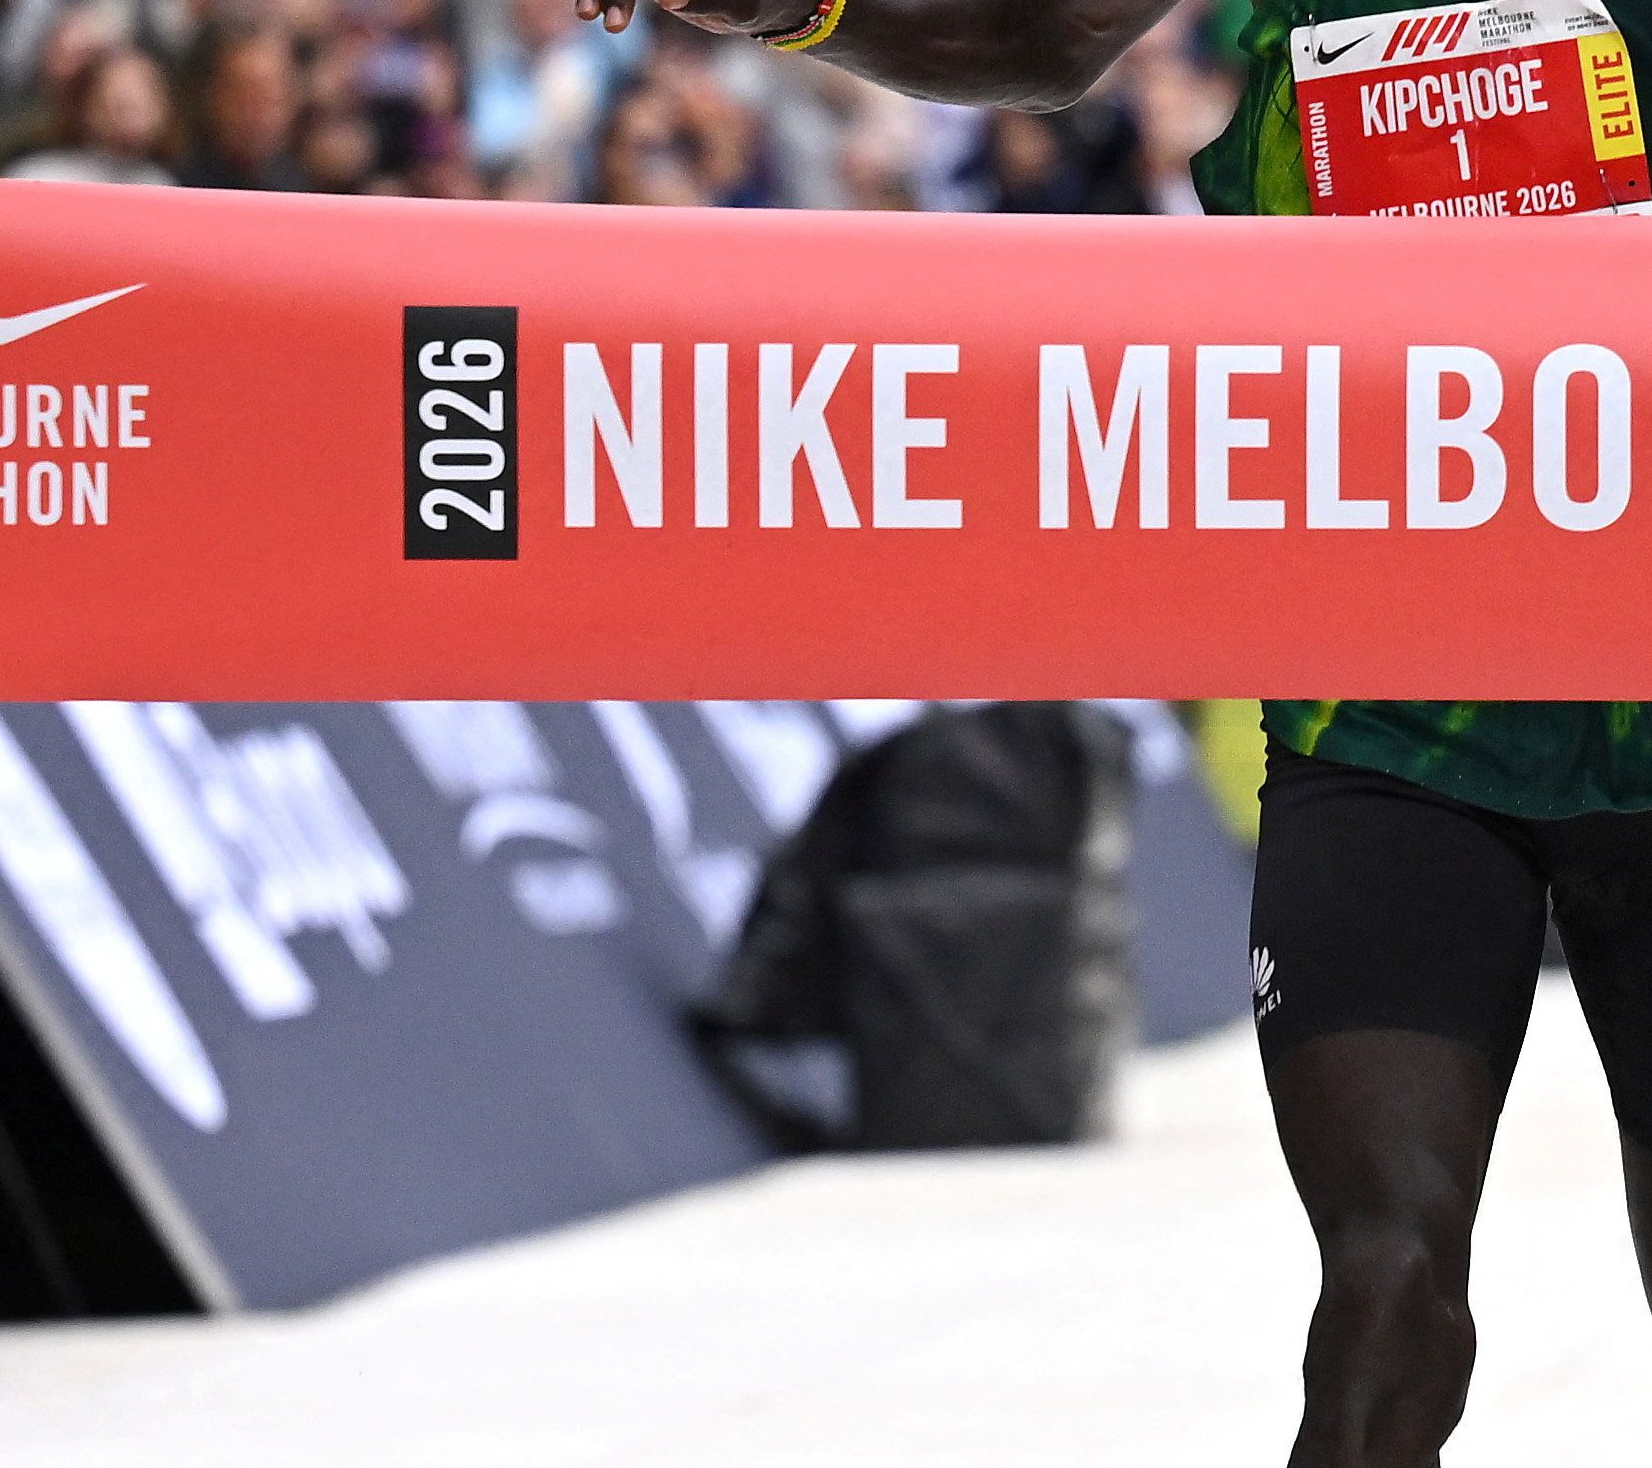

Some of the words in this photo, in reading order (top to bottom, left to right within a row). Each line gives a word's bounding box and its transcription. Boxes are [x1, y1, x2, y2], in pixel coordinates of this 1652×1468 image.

[1479, 11, 1536, 27] MELBOURNE
[1480, 22, 1532, 38] MARATHON
[1359, 58, 1549, 137] KIPCHOGE
[1591, 50, 1635, 141] ELITE
[1308, 101, 1334, 198] MARATHON
[1450, 128, 1471, 181] 1
[1369, 190, 1511, 216] BOURNE
[1516, 180, 1577, 215] 2026
[418, 338, 506, 532] 2026
[564, 342, 963, 529] NIKE
